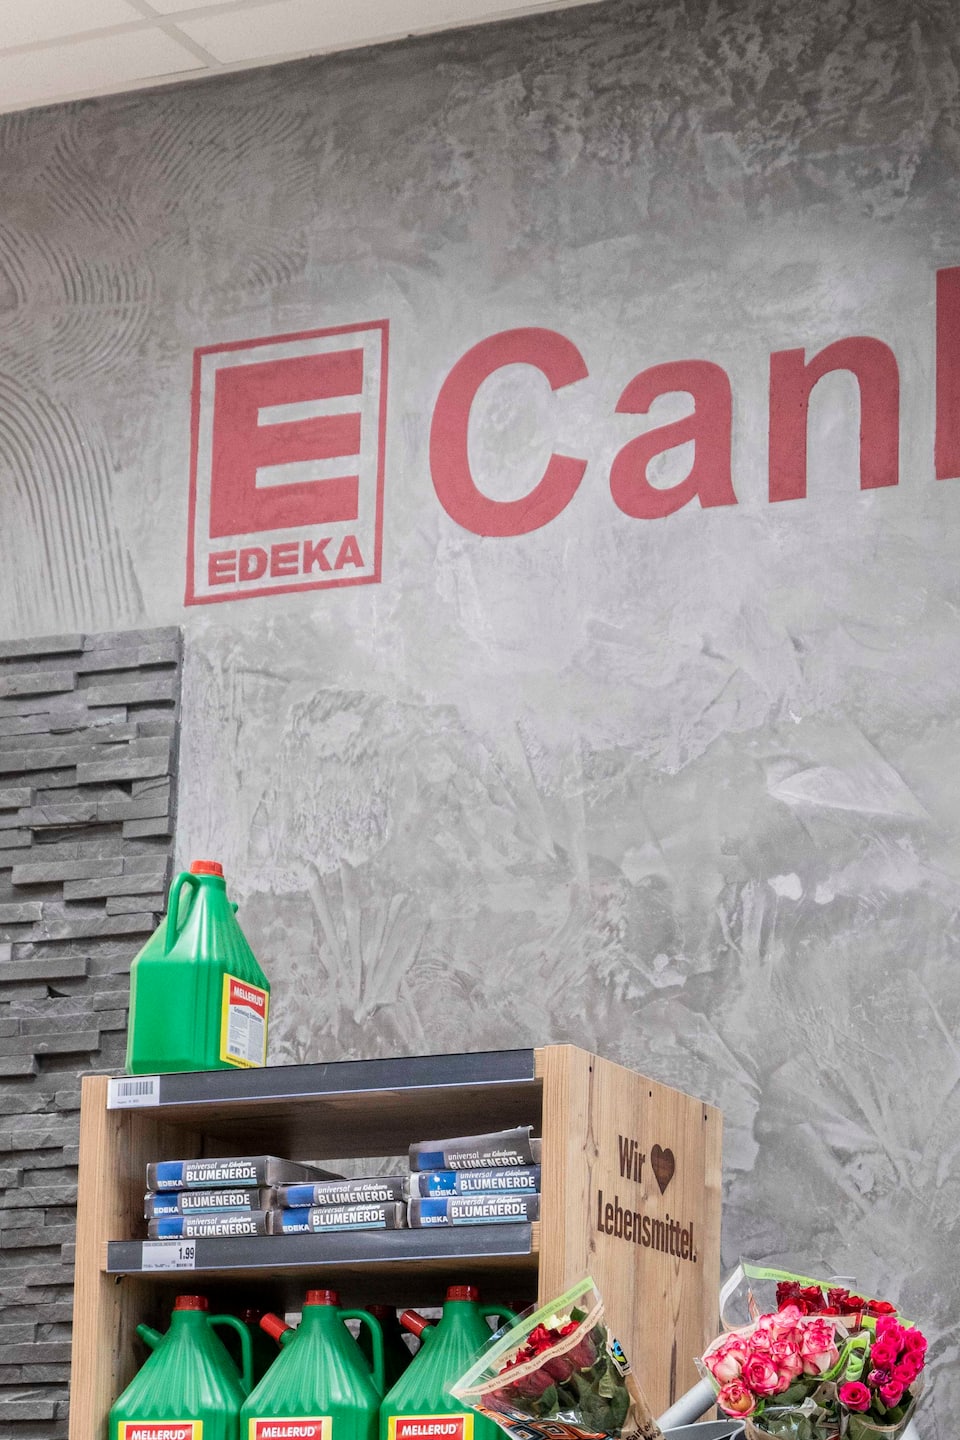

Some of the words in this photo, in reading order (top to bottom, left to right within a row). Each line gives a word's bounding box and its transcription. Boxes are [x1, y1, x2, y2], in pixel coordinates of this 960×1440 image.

[207, 534, 365, 587] EDEKA
[233, 985, 265, 1007] MELLERUD
[449, 1156, 527, 1170] BLUMENERDE
[618, 1134, 646, 1184] Wir
[186, 1167, 257, 1181] BLUMENERDE
[460, 1176, 536, 1190] BLUMENERDE
[182, 1194, 251, 1208] BLUMENERDE
[319, 1190, 395, 1205] BLUMENERDE
[153, 1206, 179, 1214] EDEKA
[451, 1203, 528, 1218] BLUMENERDE
[312, 1209, 386, 1226] BLUMENERDE
[186, 1222, 258, 1237] BLUMENERDE
[597, 1189, 698, 1264] Lebensmittel.
[178, 1247, 195, 1260] 1.99
[131, 1430, 186, 1440] MELLERUD
[261, 1426, 316, 1438] MELLERUD
[402, 1423, 457, 1436] MELLERUD
